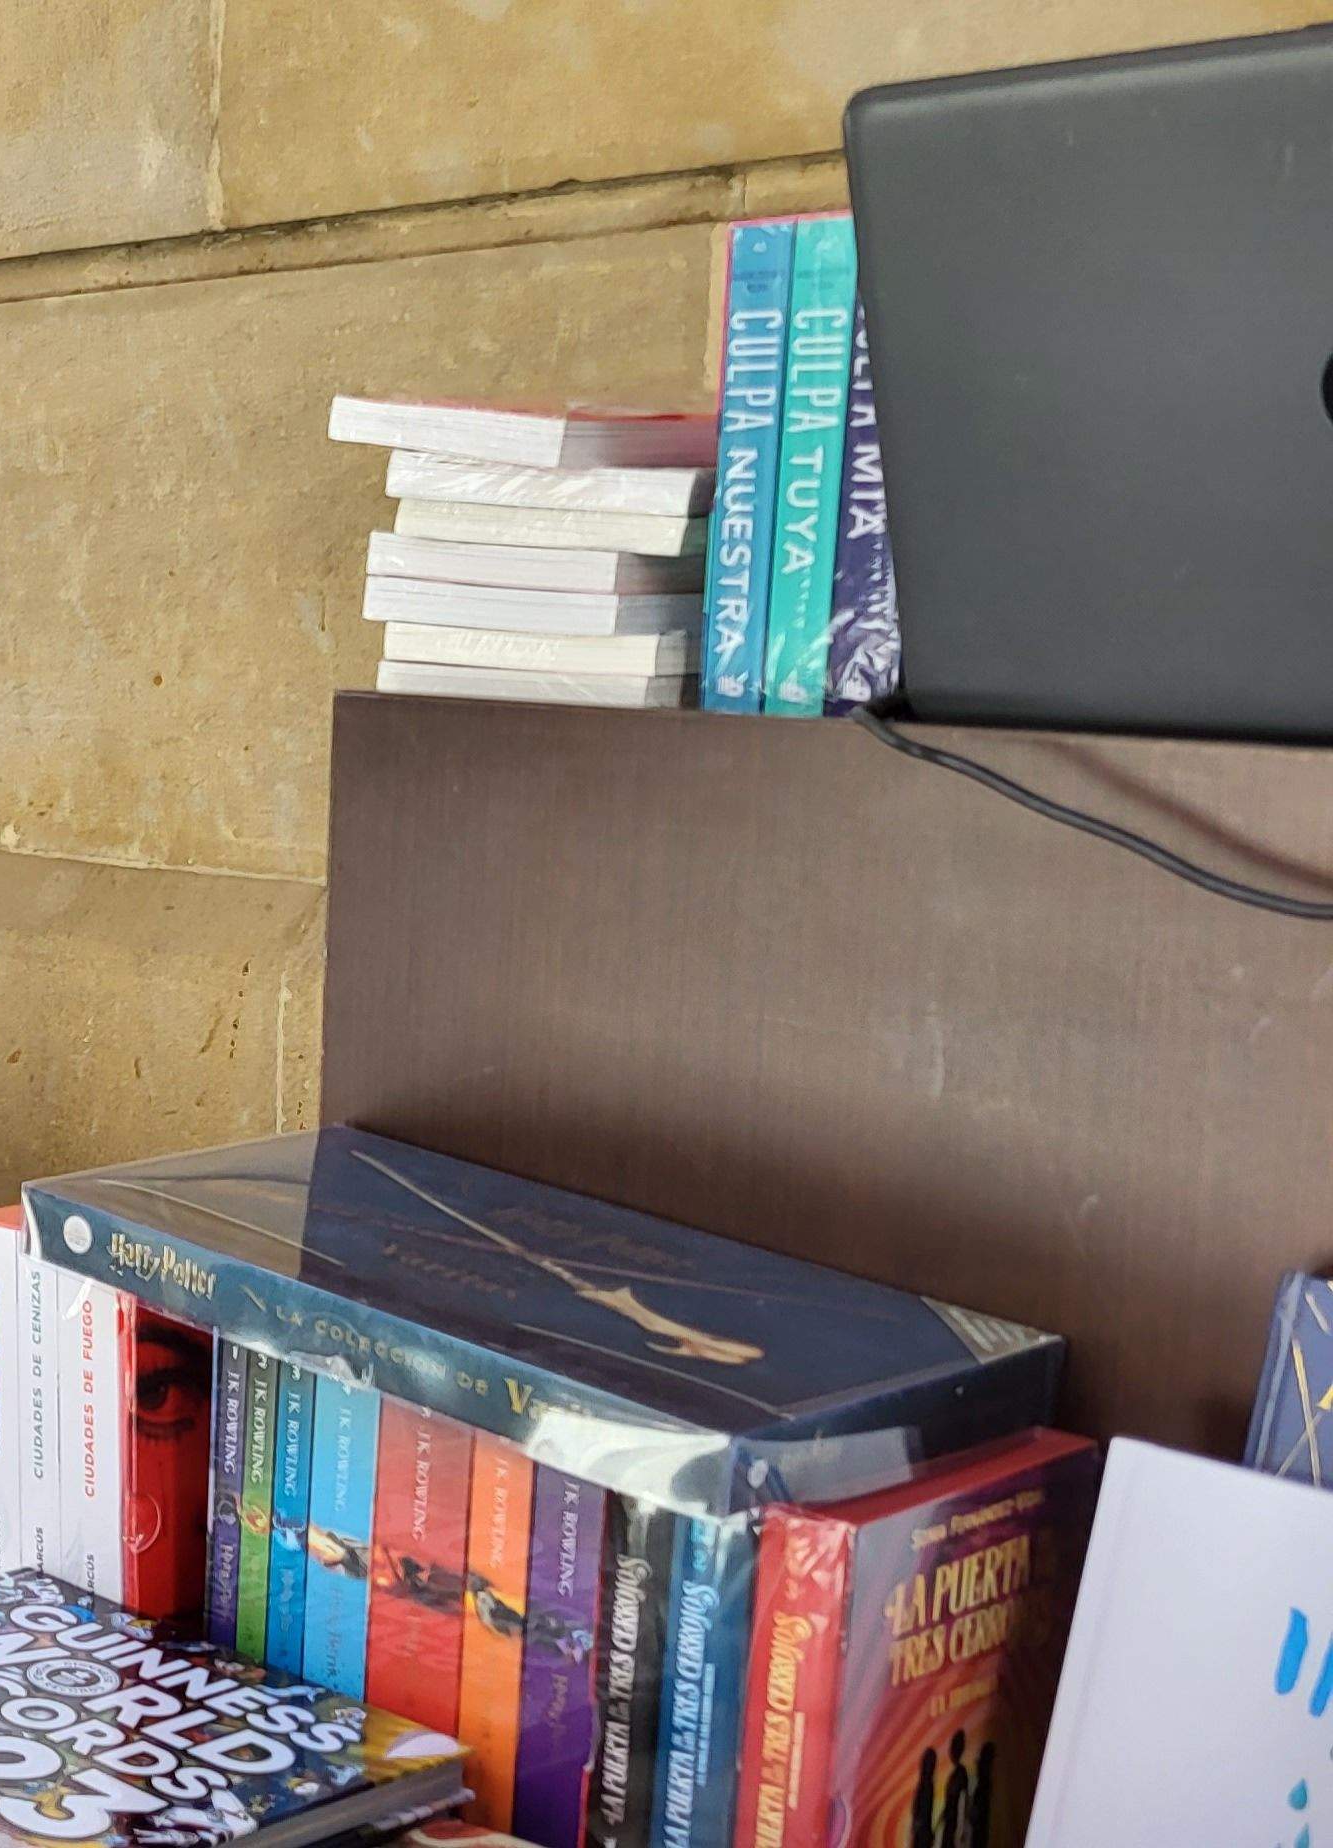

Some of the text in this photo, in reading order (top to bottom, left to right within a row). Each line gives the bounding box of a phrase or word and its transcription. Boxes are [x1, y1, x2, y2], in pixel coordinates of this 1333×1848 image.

[723, 308, 783, 432] CULPA
[785, 308, 848, 432] CULPA
[781, 445, 825, 575] TUYA
[713, 449, 759, 656] NUESTRA
[107, 1233, 218, 1301] Harry Potter
[32, 1271, 44, 1480] CIUDADES DE CENIZAS
[83, 1300, 95, 1498] CIUDADES DE FUEGO
[224, 1395, 240, 1474] ROWLING
[250, 1405, 266, 1483] ROWLING
[284, 1417, 299, 1497] ROWLING
[334, 1433, 350, 1512] ROWLING
[413, 1458, 429, 1542] ROWLING
[36, 1526, 44, 1573] ARCÚS
[86, 1553, 94, 1593] RCÚS
[557, 1506, 578, 1598] ROWLING
[932, 1534, 1030, 1622] PUERTA
[611, 1554, 653, 1649] CERROJOS
[677, 1581, 718, 1680] CERROJOS
[9, 1604, 363, 1759] GUINNESS
[609, 1648, 635, 1694] TRES
[765, 1611, 812, 1704] CERROJOS
[890, 1624, 947, 1687] TRES
[671, 1680, 700, 1729] TRES
[764, 1702, 793, 1750] TRES
[605, 1716, 631, 1787] PUERTA
[667, 1748, 695, 1813] PUERTA
